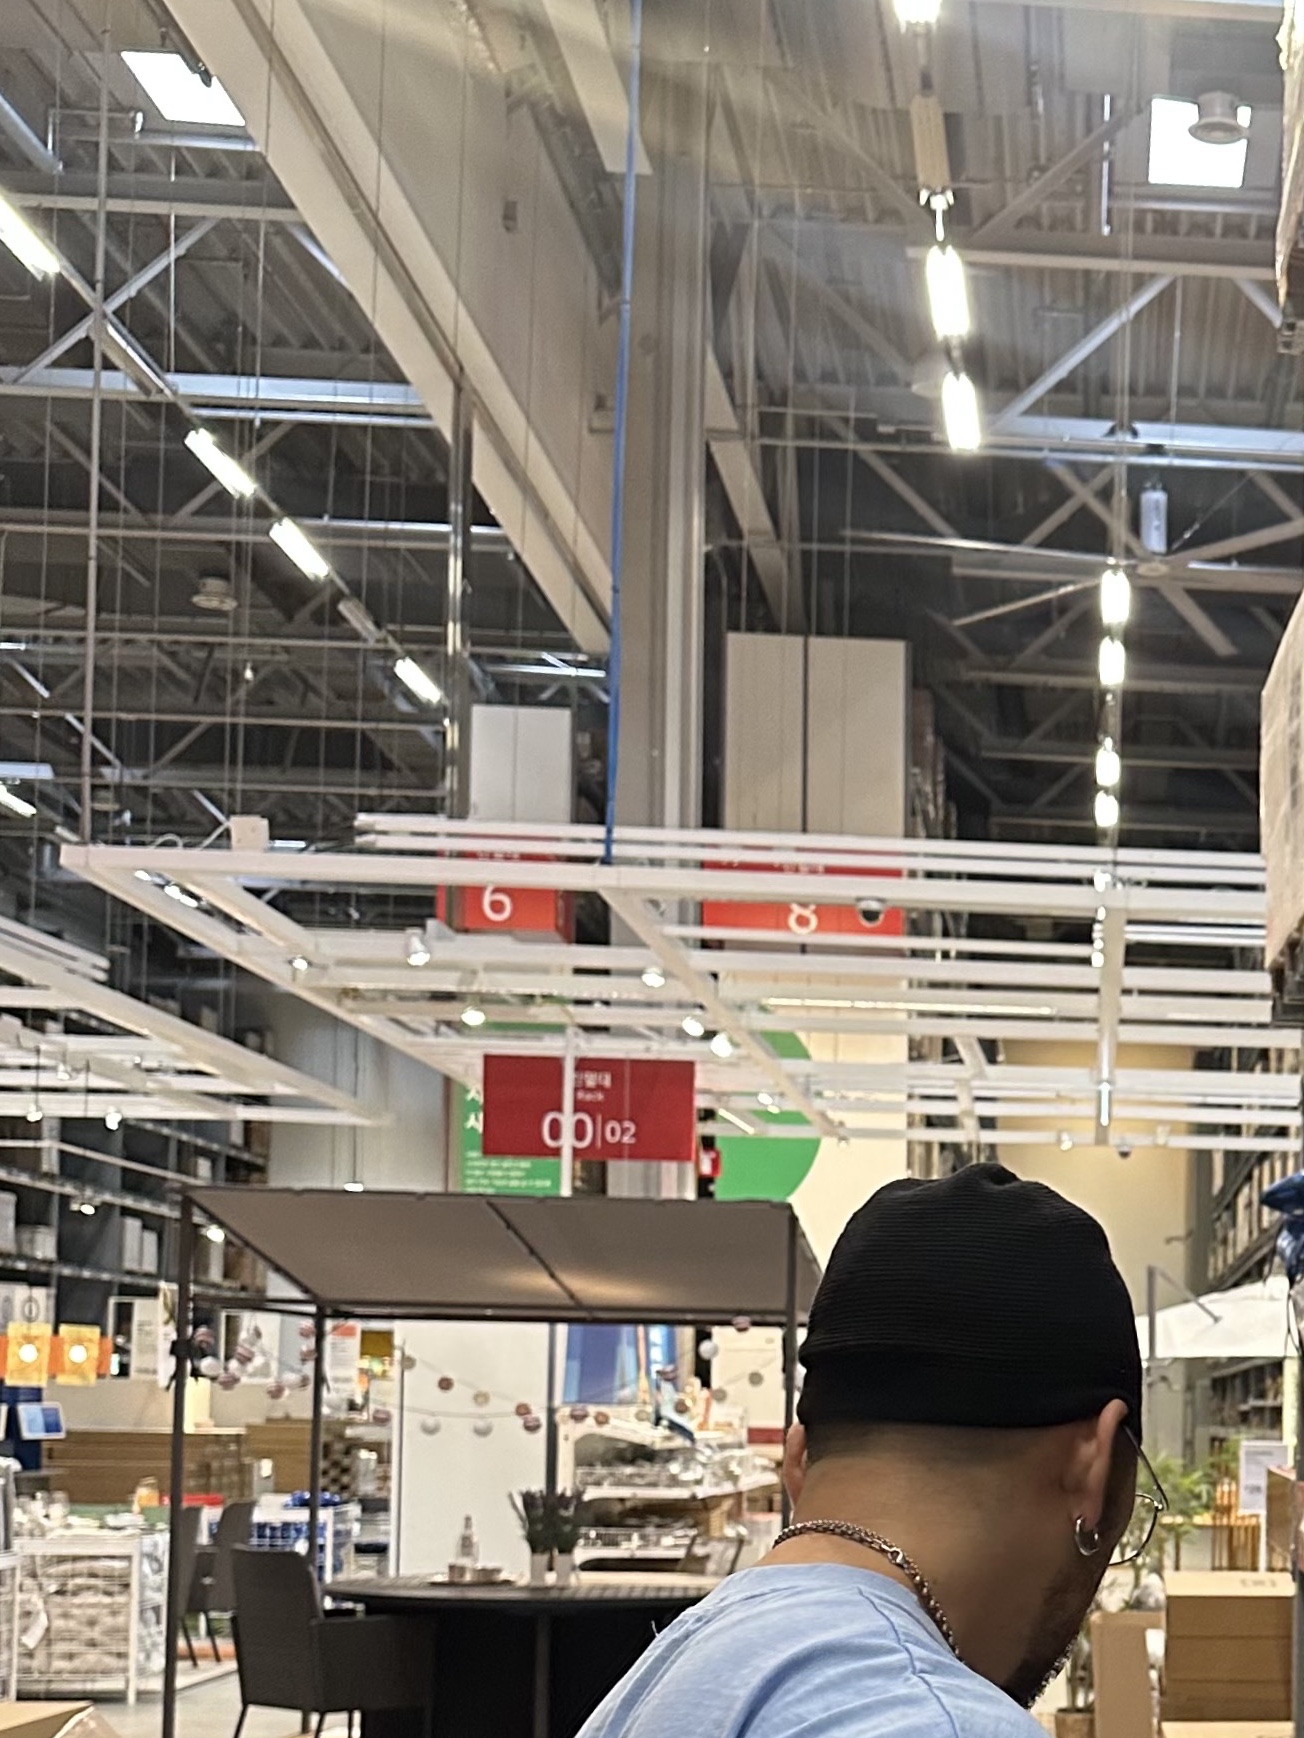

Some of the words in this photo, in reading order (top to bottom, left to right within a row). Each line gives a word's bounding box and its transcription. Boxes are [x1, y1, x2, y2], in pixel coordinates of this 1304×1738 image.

[482, 884, 513, 922] 6
[787, 902, 819, 935] 8
[541, 1111, 594, 1149] 00
[604, 1119, 637, 1144] 02
